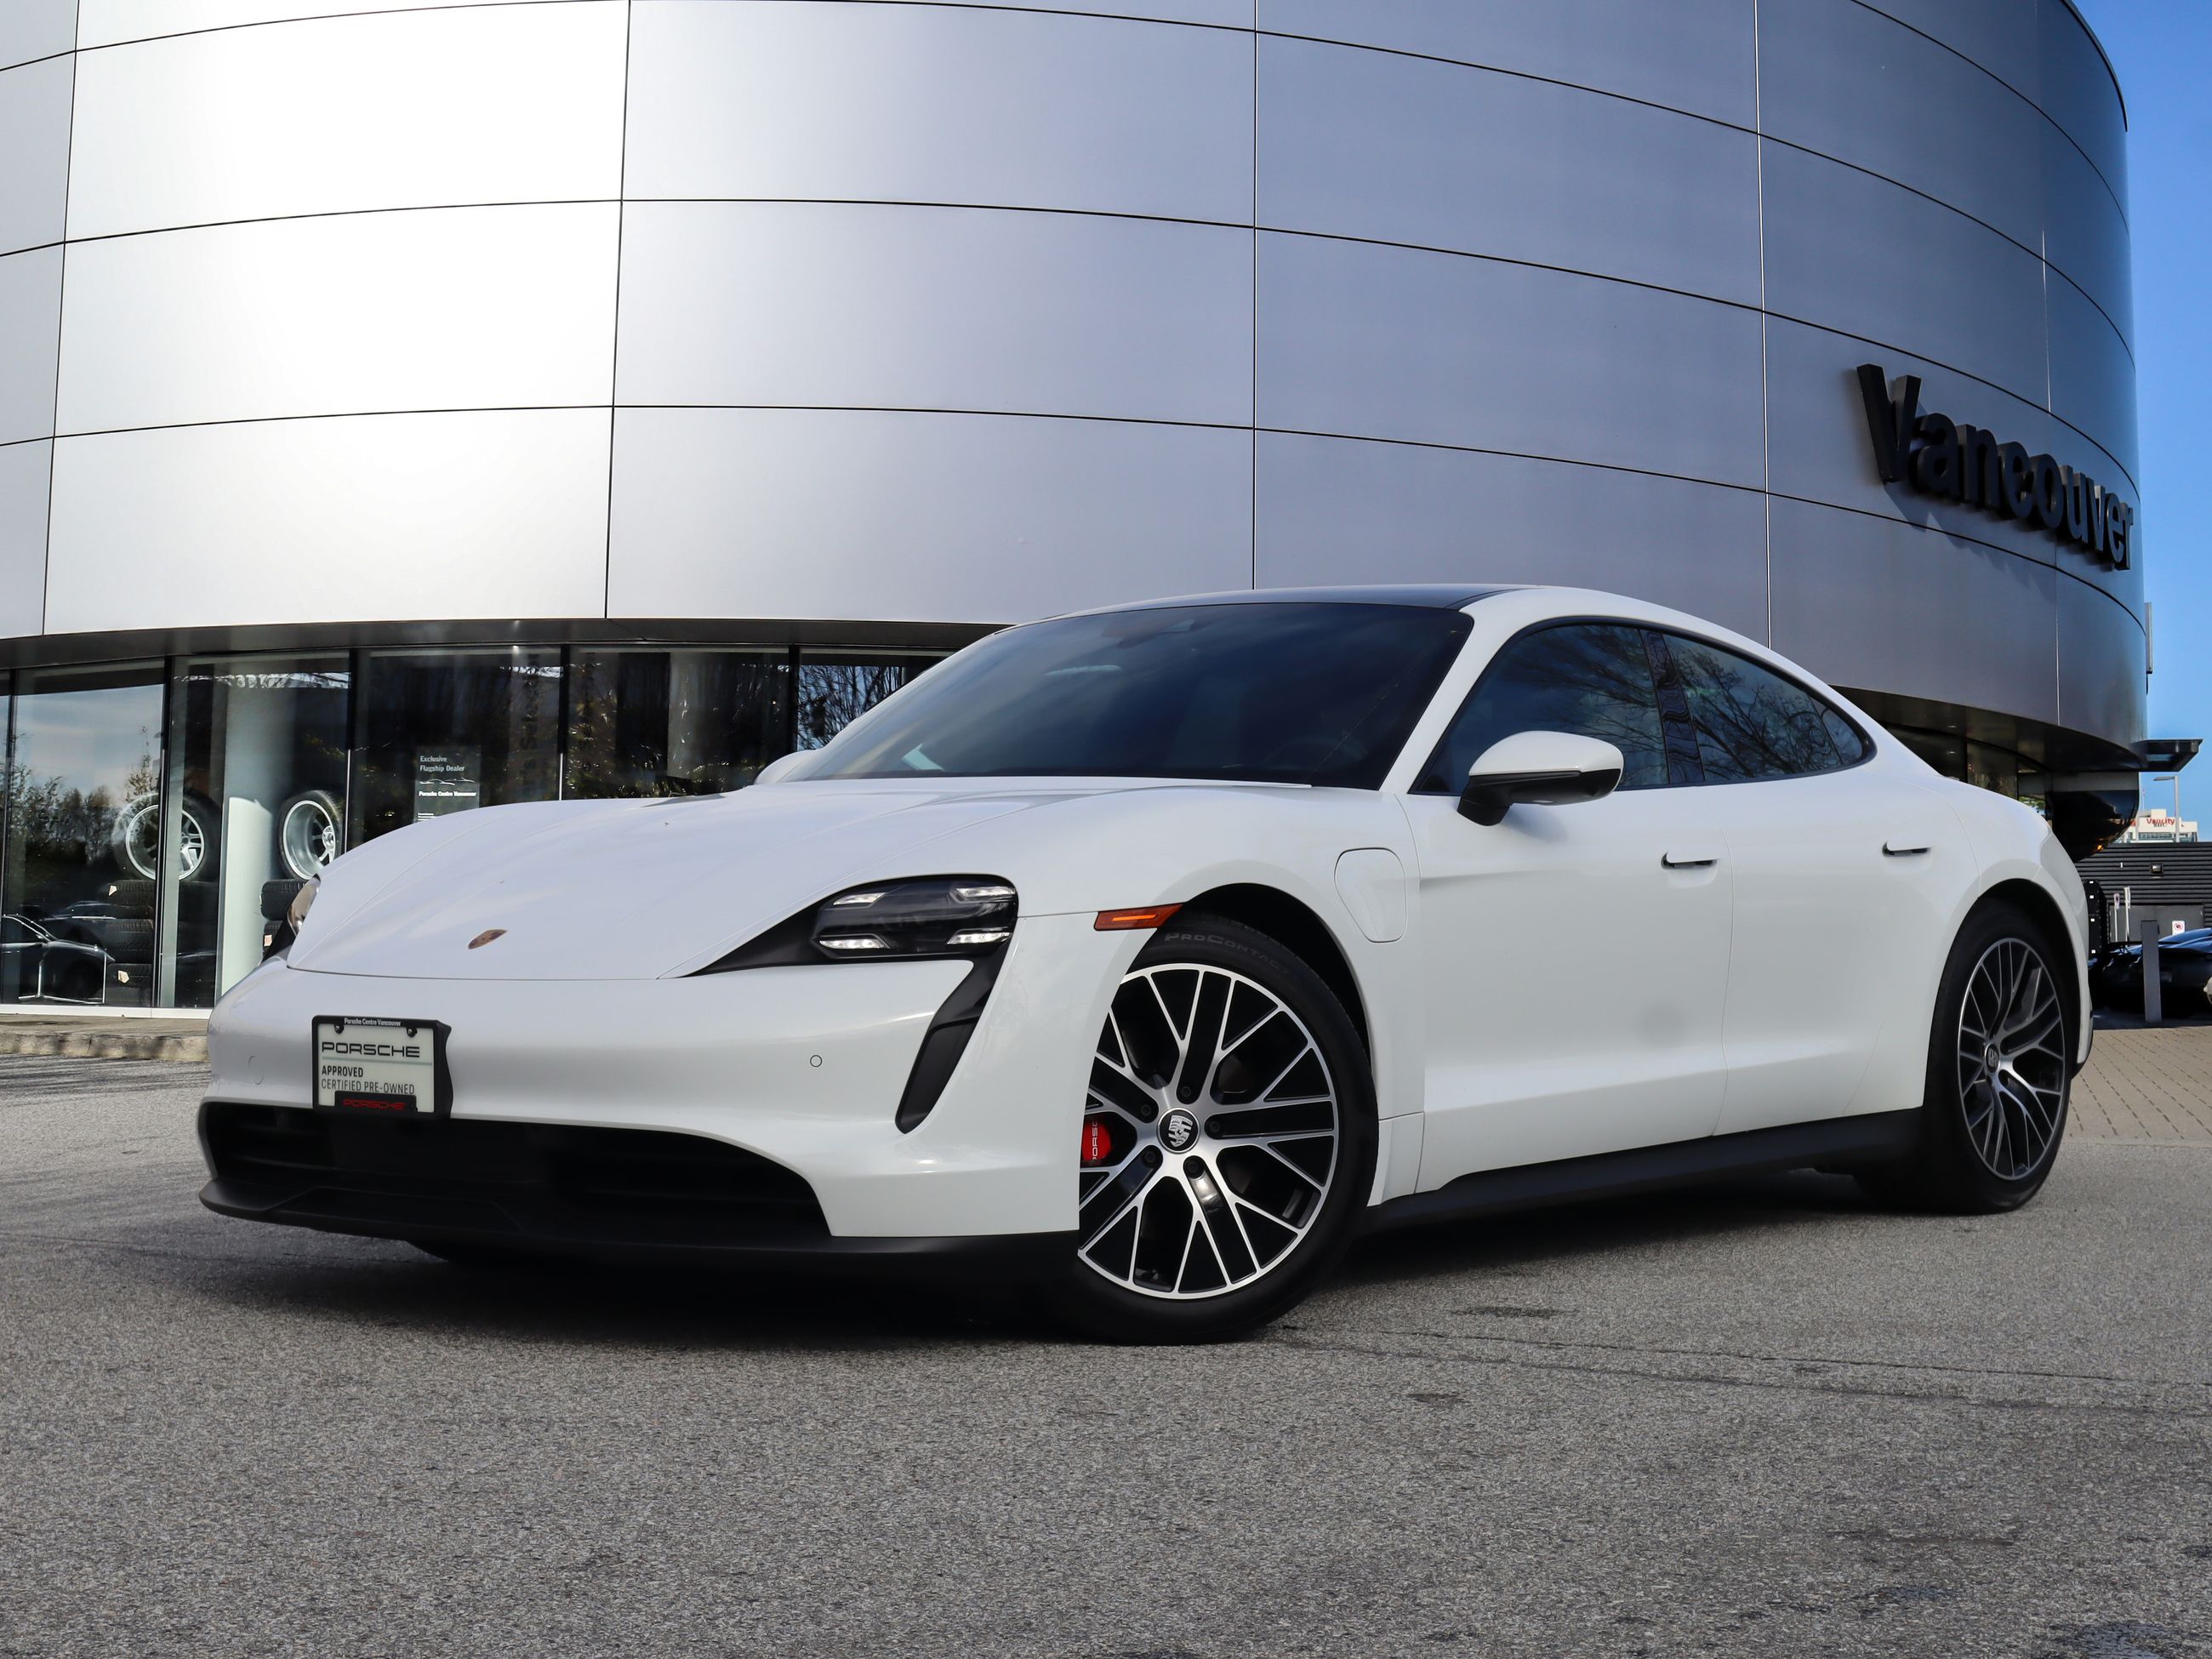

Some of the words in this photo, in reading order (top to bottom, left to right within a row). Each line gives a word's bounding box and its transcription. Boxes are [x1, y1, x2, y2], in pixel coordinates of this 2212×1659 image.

[1857, 363, 2134, 571] Vancouver
[322, 1041, 420, 1058] PORSCHE
[321, 1065, 364, 1078] APPROVED
[321, 1078, 362, 1092] CERTIFIED
[363, 1081, 415, 1095] PRE-OWNED
[343, 1098, 407, 1109] PORSCHE
